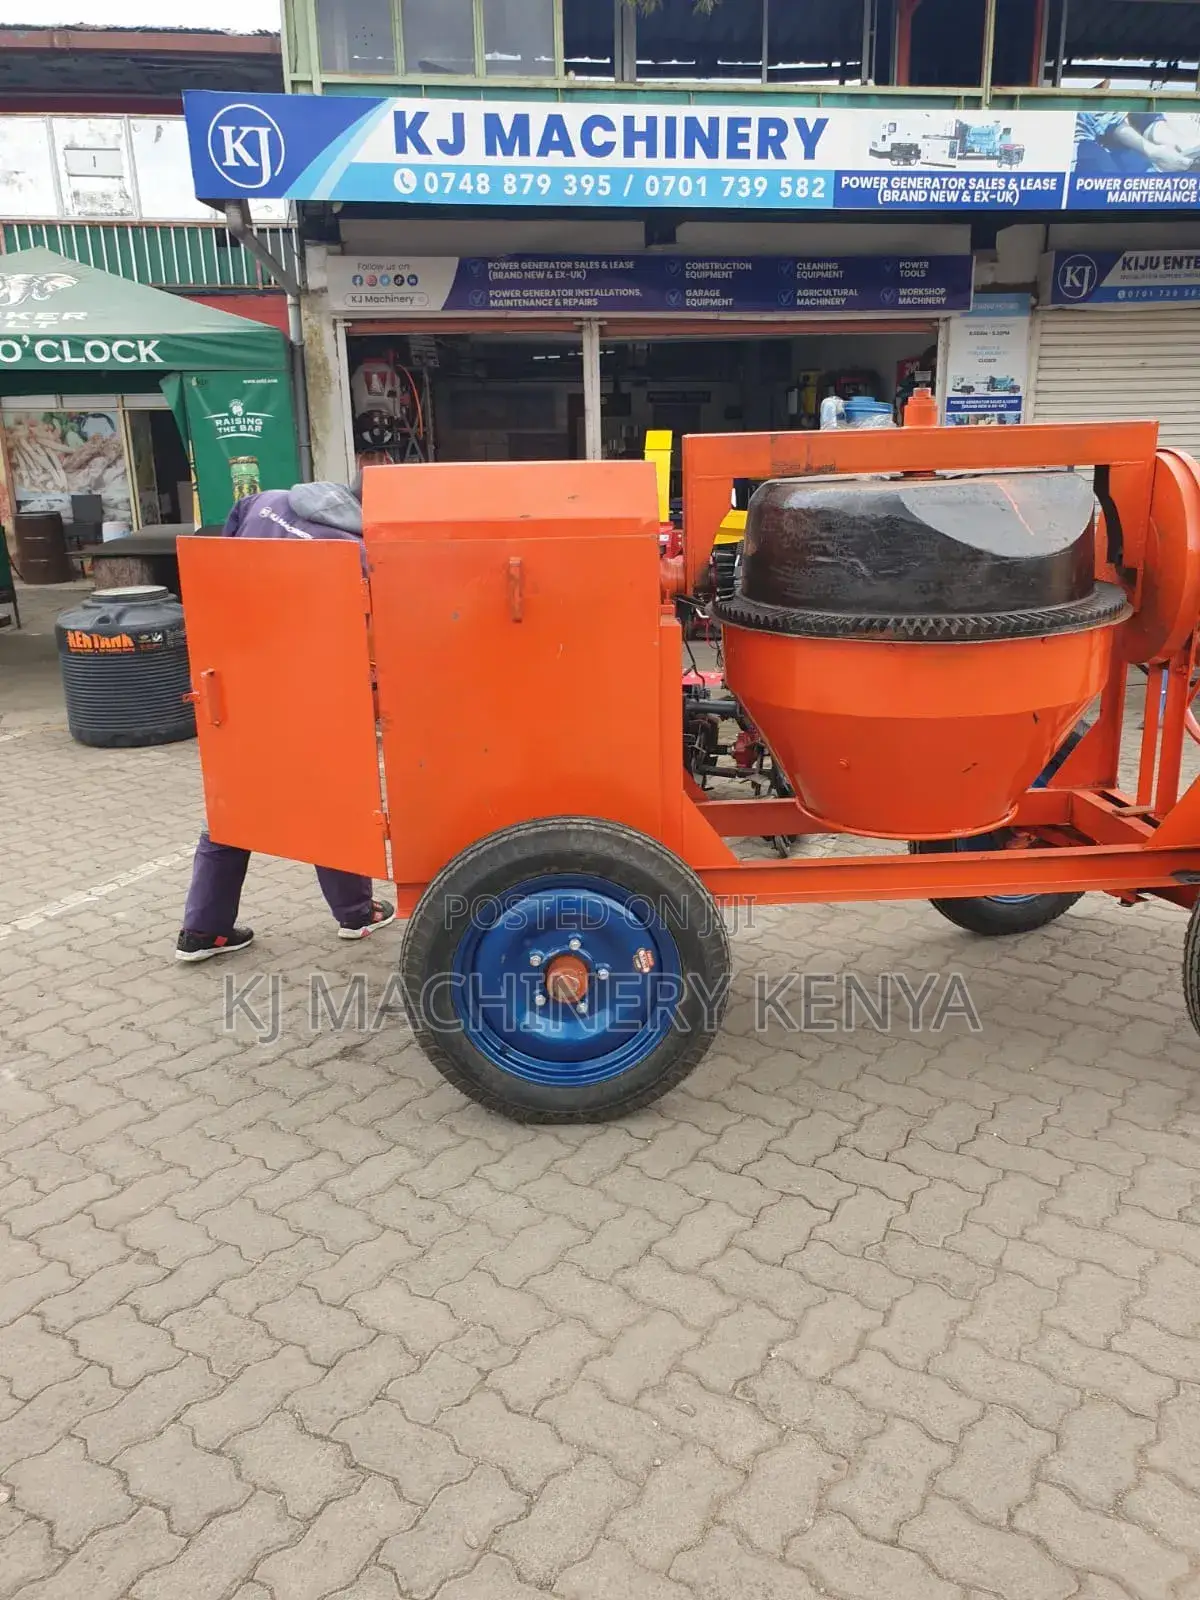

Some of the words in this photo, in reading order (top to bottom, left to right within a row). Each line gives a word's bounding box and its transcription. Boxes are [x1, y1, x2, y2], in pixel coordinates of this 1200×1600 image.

[393, 110, 466, 156] KJ
[484, 113, 830, 160] MACHINERY
[218, 125, 272, 188] KJ
[423, 171, 491, 195] 0748
[503, 173, 551, 196] 879
[563, 174, 612, 196] 395
[623, 174, 634, 198] /
[645, 175, 707, 198] 0701
[720, 176, 768, 198] 739
[779, 177, 826, 198] 582
[841, 176, 887, 189] POWER
[891, 177, 966, 190] GENERATOR
[968, 178, 1005, 190] SALES
[1007, 178, 1018, 190] &
[1020, 178, 1057, 190] LEASE
[1076, 178, 1121, 190] POWER
[1123, 178, 1197, 190] GENERATOR
[877, 185, 928, 204] (BRAND
[929, 190, 960, 203] NEW
[961, 190, 972, 203] &
[973, 187, 1020, 206] EX-UK)
[1107, 190, 1198, 203] MAINTENANCE
[357, 262, 384, 271] Follow
[386, 263, 396, 271] us
[398, 262, 411, 271] on
[487, 262, 520, 270] POWER
[521, 261, 573, 270] GENERATOR
[574, 260, 600, 269] SALES
[601, 261, 608, 269] &
[609, 260, 635, 269] LEASE
[685, 262, 753, 271] CONSTRUCTION
[796, 262, 839, 271] CLEANING
[899, 261, 929, 270] POWER
[1120, 256, 1160, 271] KIJU
[488, 270, 523, 281] (BRAND
[524, 270, 545, 279] NEW
[546, 271, 553, 279] &
[554, 269, 587, 280] EX-UK)
[685, 270, 734, 280] EQUIPMENT
[796, 270, 845, 279] EQUIPMENT
[899, 269, 926, 278] TOOLS
[1063, 264, 1093, 298] KJ
[489, 289, 520, 298] POWER
[522, 289, 574, 298] GENERATOR
[575, 288, 643, 298] INSTALLATIONS,
[685, 289, 721, 298] GARAGE
[796, 288, 859, 298] AGRICULTURAL
[898, 287, 947, 296] WORKSHOP
[351, 295, 363, 304] KJ
[364, 294, 415, 305] Machinery
[490, 298, 553, 307] MAINTENANCE
[554, 299, 561, 307] &
[563, 298, 599, 307] REPAIRS
[685, 298, 735, 307] EQUIPMENT
[796, 297, 847, 307] MACHINERY
[898, 296, 947, 305] MACHINERY
[0, 311, 88, 321] KER
[0, 334, 165, 363] O'CLOCK
[215, 417, 263, 427] RAISING
[217, 425, 237, 433] THE
[240, 424, 262, 433] BAR
